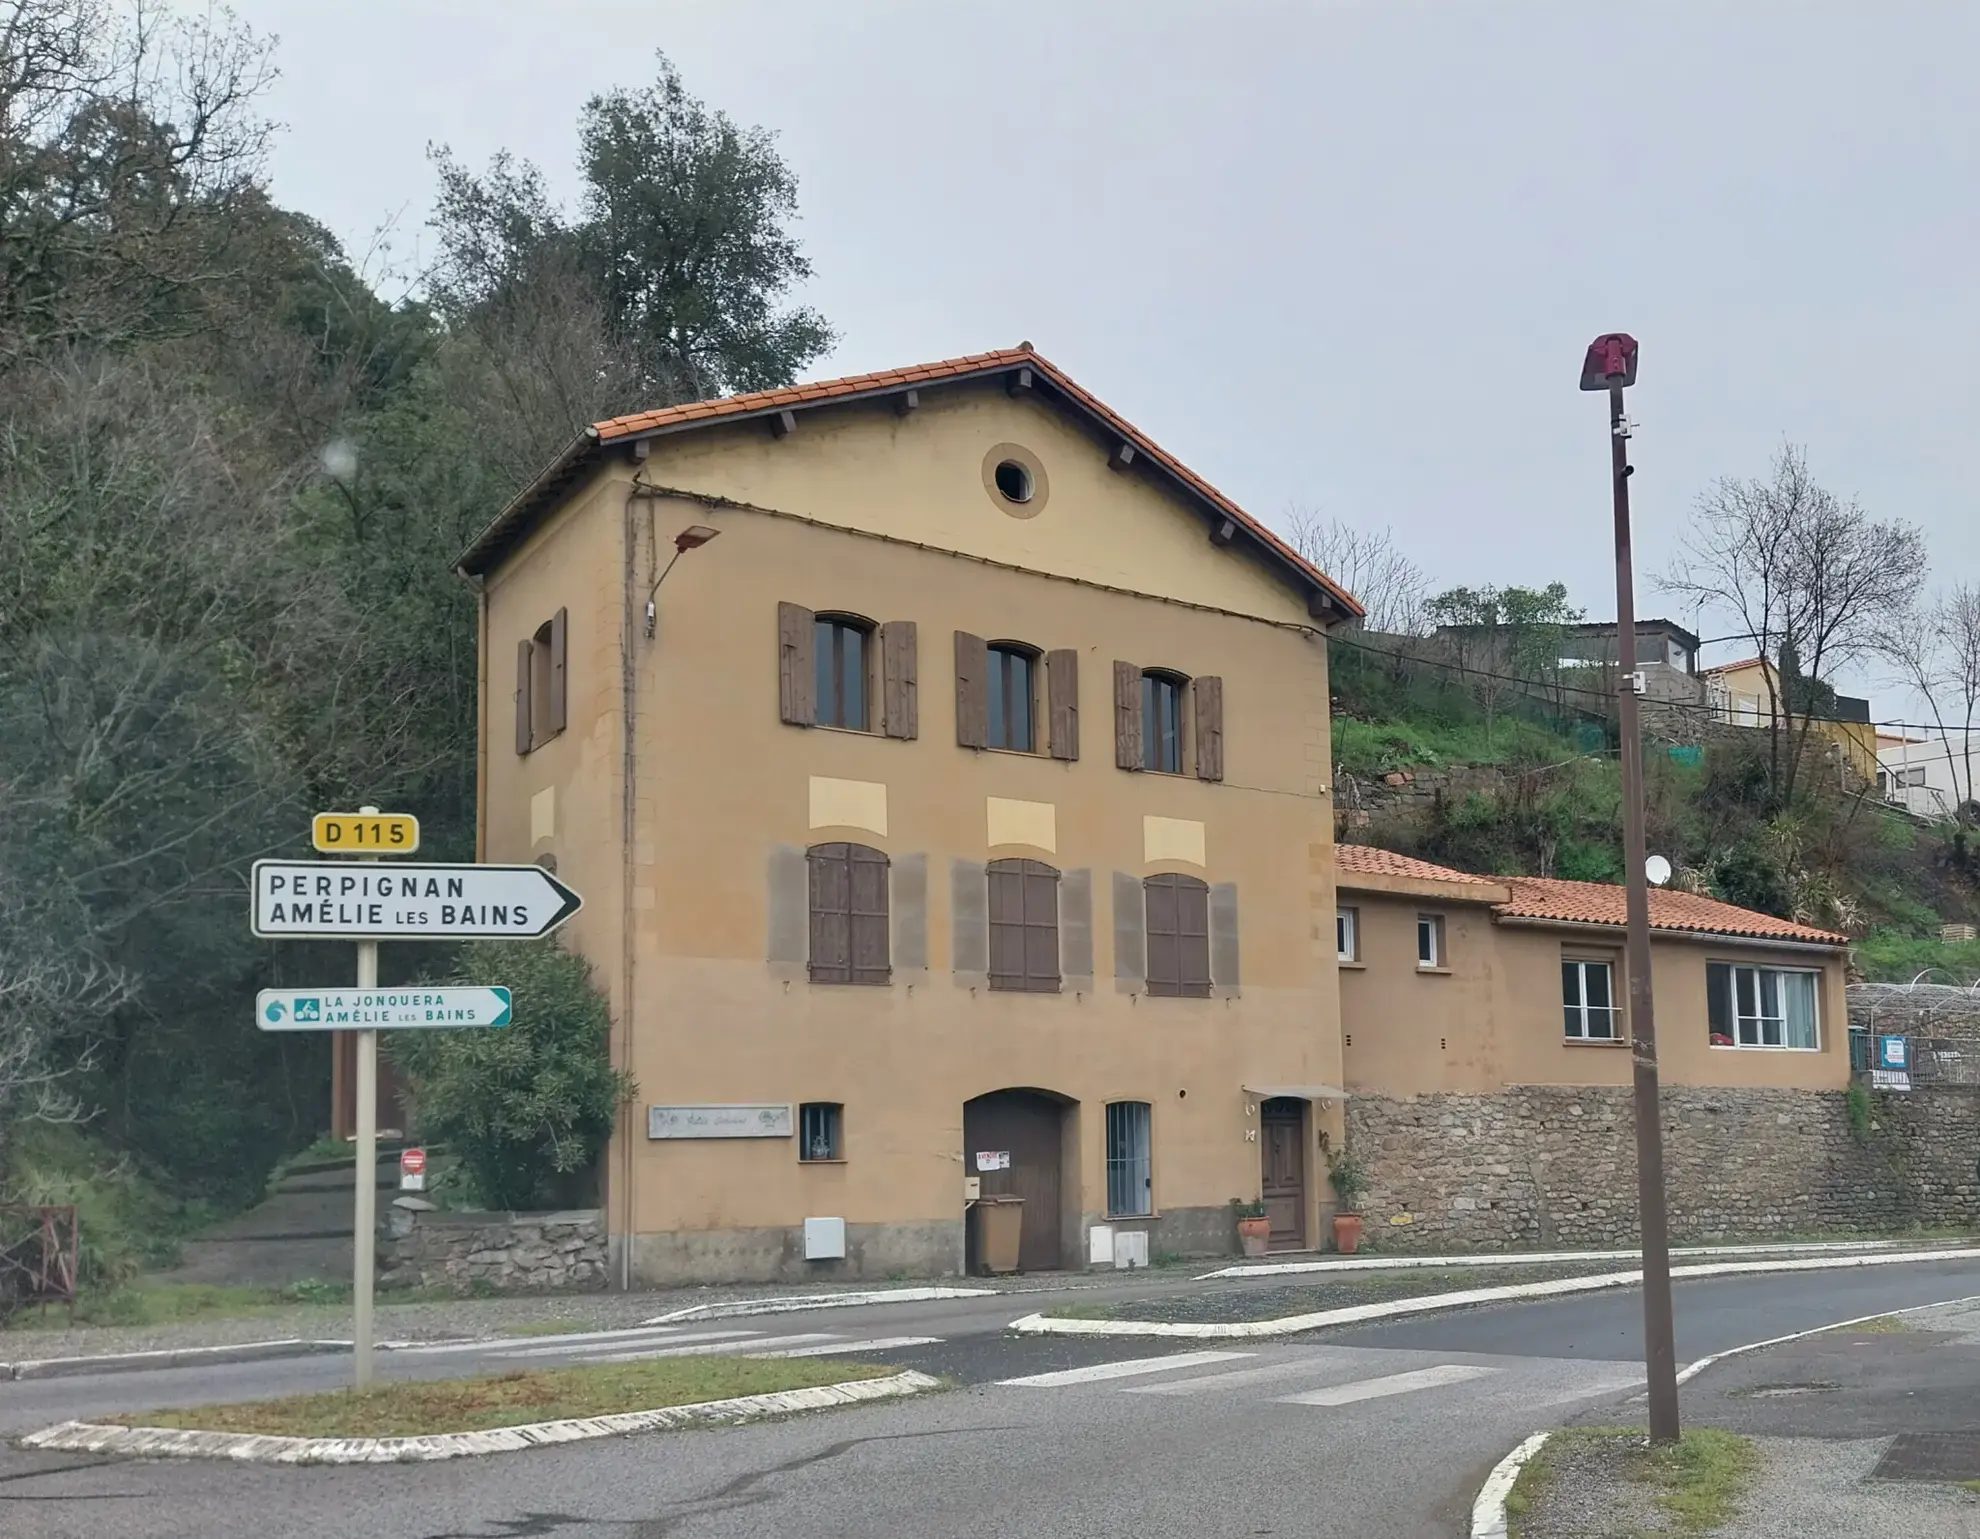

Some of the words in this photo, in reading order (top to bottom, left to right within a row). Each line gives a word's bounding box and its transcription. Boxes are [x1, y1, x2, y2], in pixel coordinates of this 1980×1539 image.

[326, 823, 342, 843] D
[354, 823, 405, 844] 115
[270, 875, 464, 898] PERPIGNAN
[270, 899, 383, 924] AMÉLIE
[396, 911, 428, 925] LES
[441, 905, 529, 926] BAINS
[325, 997, 344, 1008] LA
[325, 1007, 390, 1023] AMÉLIE
[425, 1009, 476, 1021] BAINS
